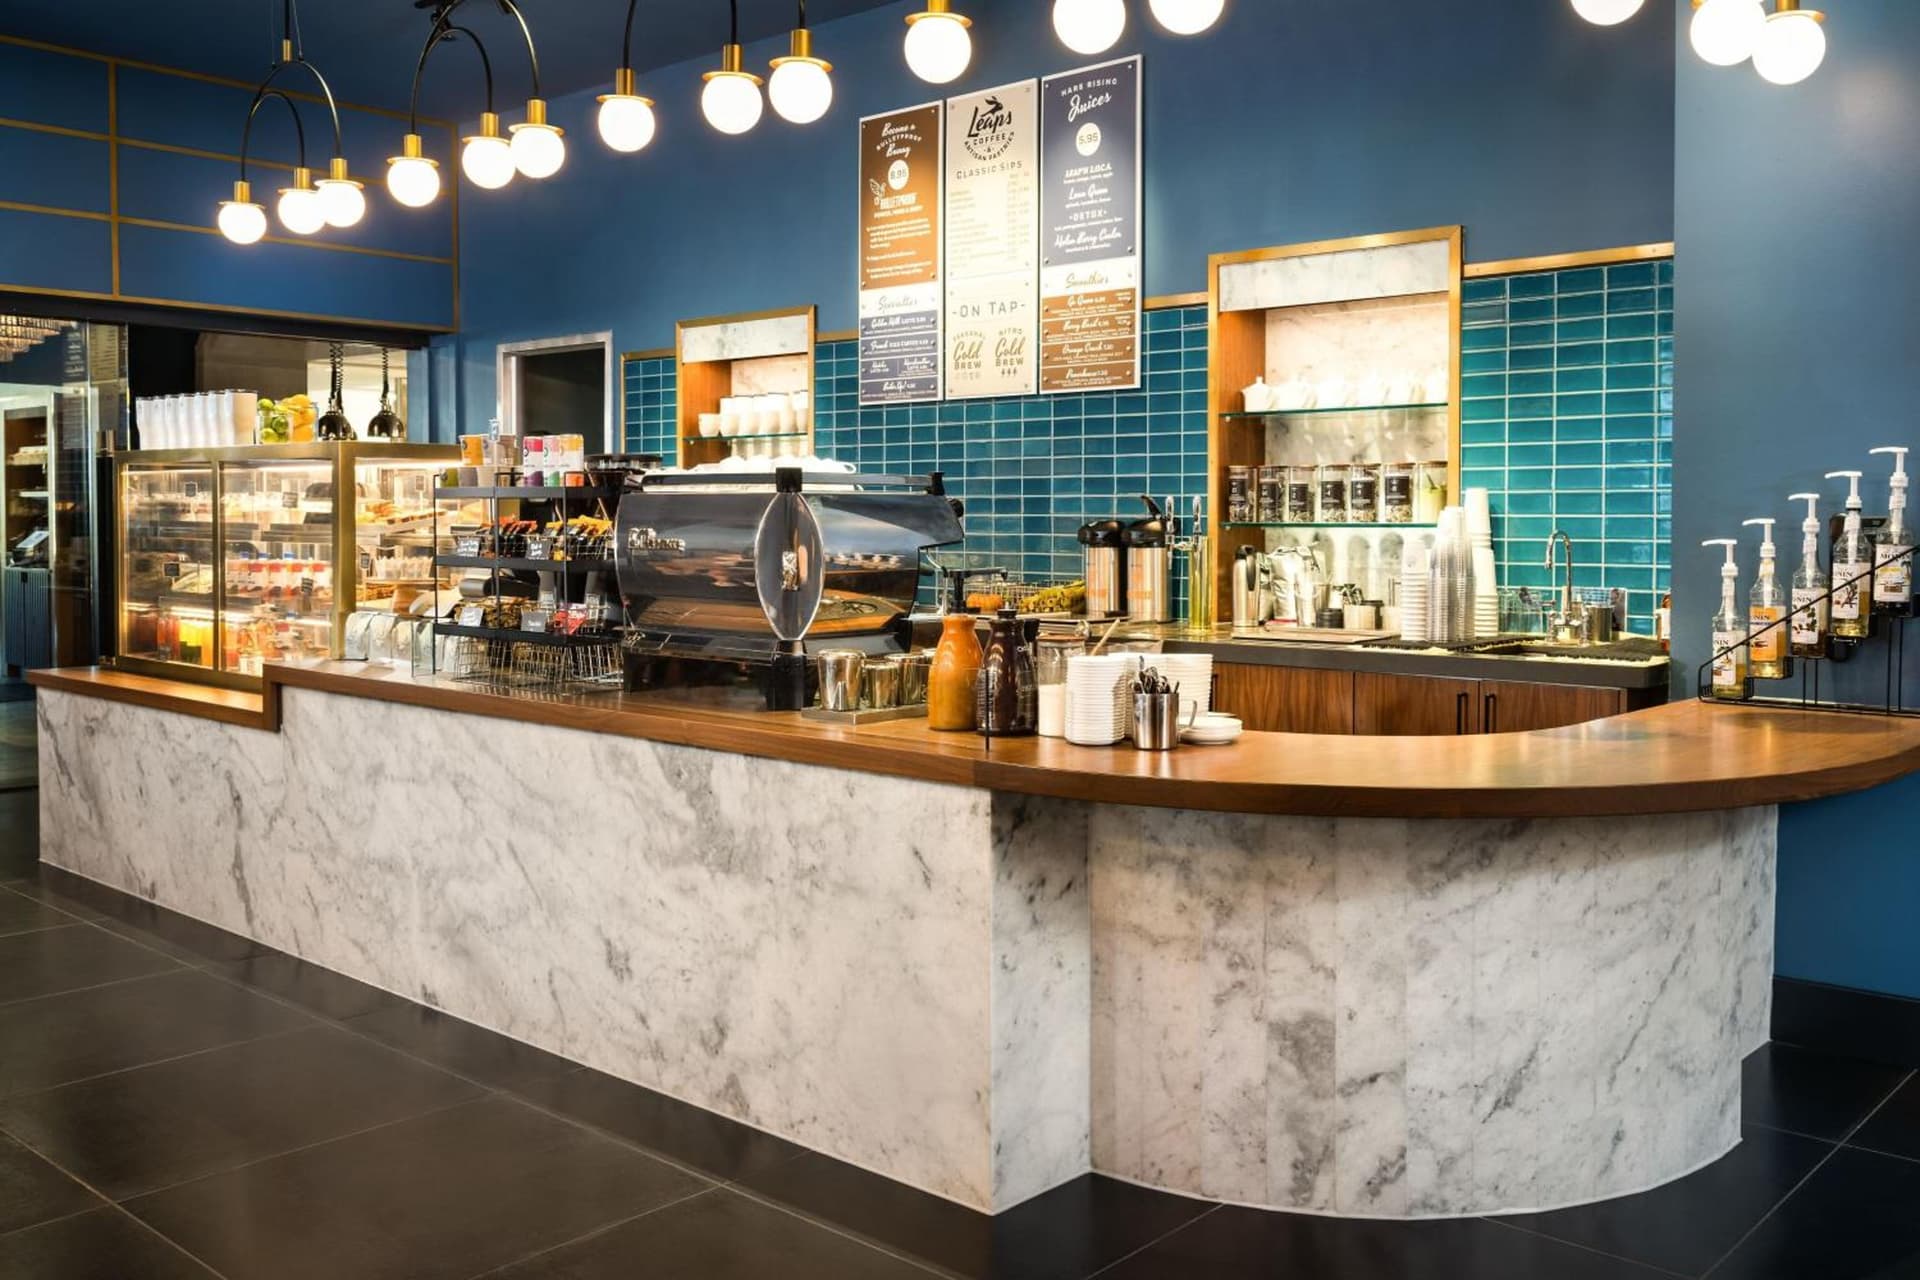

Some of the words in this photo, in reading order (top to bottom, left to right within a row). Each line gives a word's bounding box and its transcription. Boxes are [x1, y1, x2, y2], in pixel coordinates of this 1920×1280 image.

[1061, 83, 1084, 97] HARE
[1087, 77, 1118, 88] RISING
[1067, 92, 1113, 122] Juices
[967, 105, 1012, 138] Leaps
[973, 132, 1006, 146] COFFEE
[1078, 132, 1099, 145] 5.95
[956, 165, 997, 180] CLASSIC
[1000, 160, 1023, 171] SIPS
[953, 340, 984, 361] Cold
[995, 336, 1027, 358] Cold
[954, 360, 982, 370] BREW
[995, 357, 1024, 367] BREW
